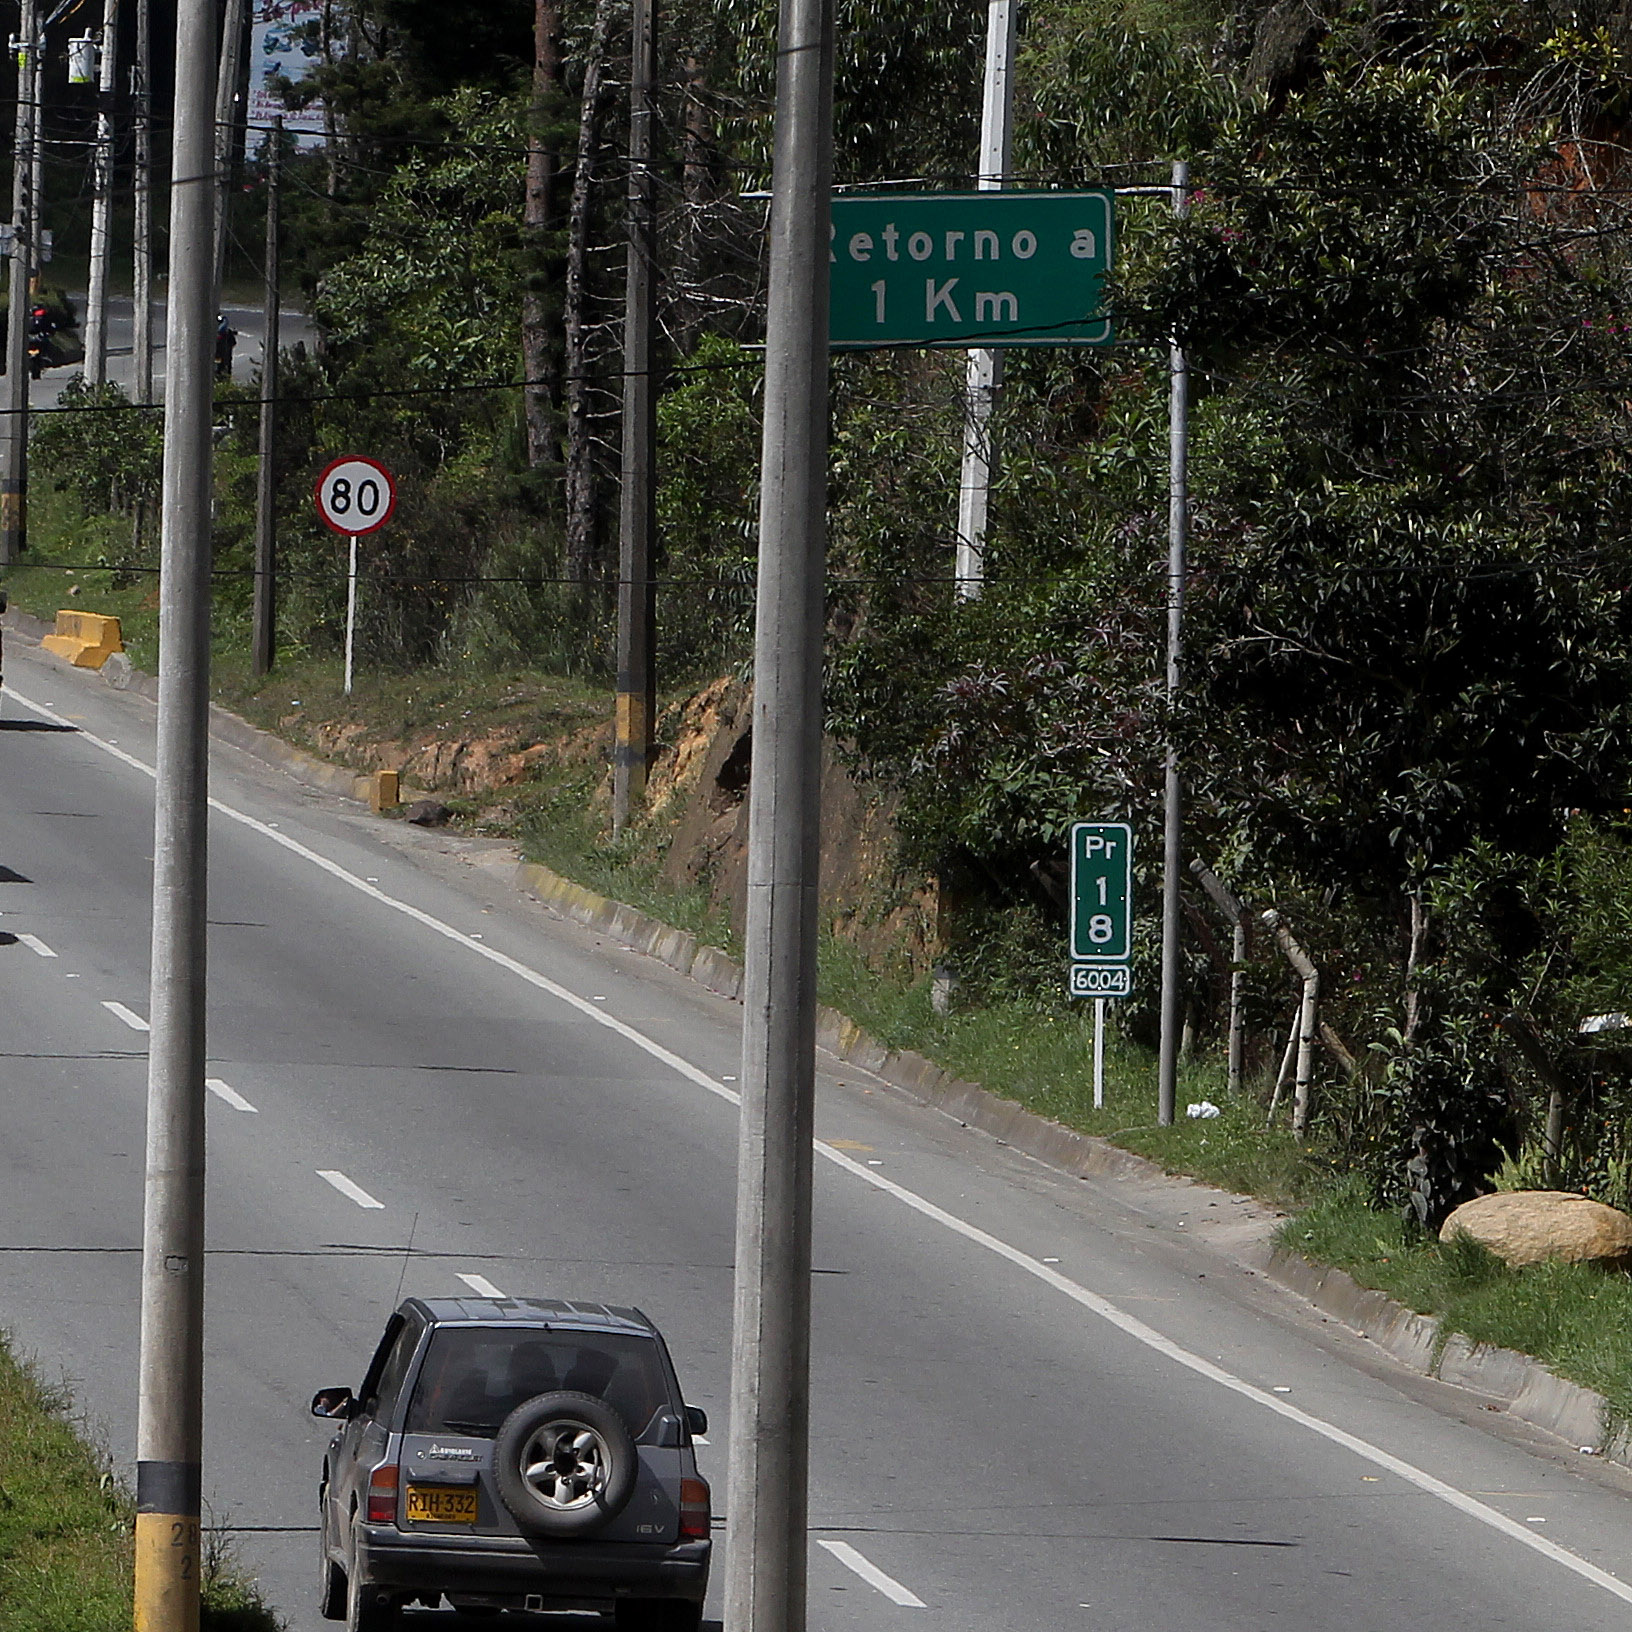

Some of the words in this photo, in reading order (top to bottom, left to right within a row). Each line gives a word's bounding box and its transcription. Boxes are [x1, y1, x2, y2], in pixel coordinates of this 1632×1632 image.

[830, 222, 1037, 262] etorno
[1070, 228, 1096, 259] a
[870, 279, 886, 324] 1
[925, 277, 1019, 323] Km
[330, 477, 380, 516] 80
[1085, 835, 1117, 860] Pr
[1088, 914, 1113, 944] 8
[1076, 970, 1125, 991] 6004
[409, 1493, 475, 1513] RIH-332
